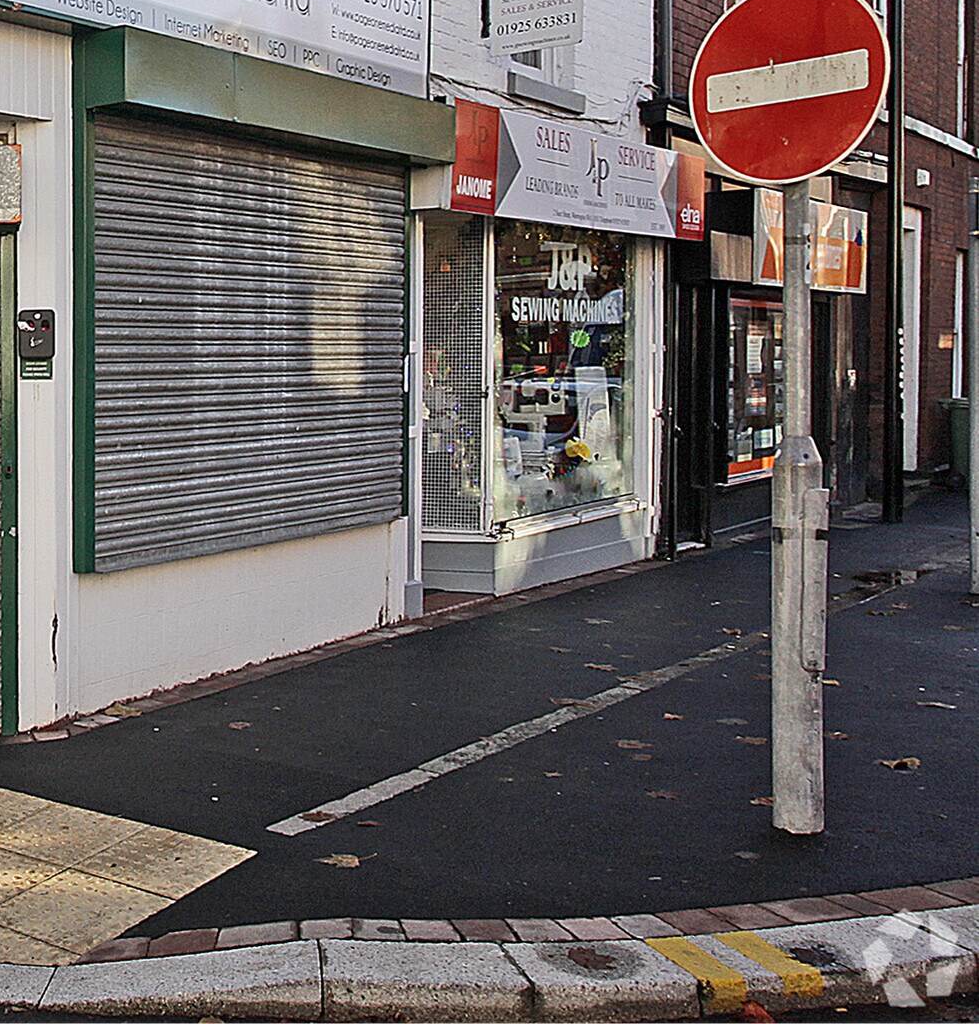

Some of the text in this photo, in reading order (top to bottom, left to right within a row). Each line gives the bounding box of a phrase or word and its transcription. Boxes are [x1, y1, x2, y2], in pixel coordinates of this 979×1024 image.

[501, 4, 527, 16] SALES
[528, 3, 534, 11] &
[497, 12, 576, 36] 01925 633831
[164, 13, 202, 38] Internet
[204, 23, 250, 53] Marketing
[268, 39, 287, 59] SEO
[303, 48, 321, 67] PPC
[336, 58, 366, 79] Graphic
[368, 66, 392, 86] Design
[536, 126, 655, 171] SALES SERVICE
[456, 174, 493, 200] JANOME
[525, 176, 554, 195] LEADING
[625, 194, 636, 208] ALL
[637, 196, 656, 211] MAKES
[680, 203, 701, 224] elna
[512, 296, 622, 325] SEWING MACHINES
